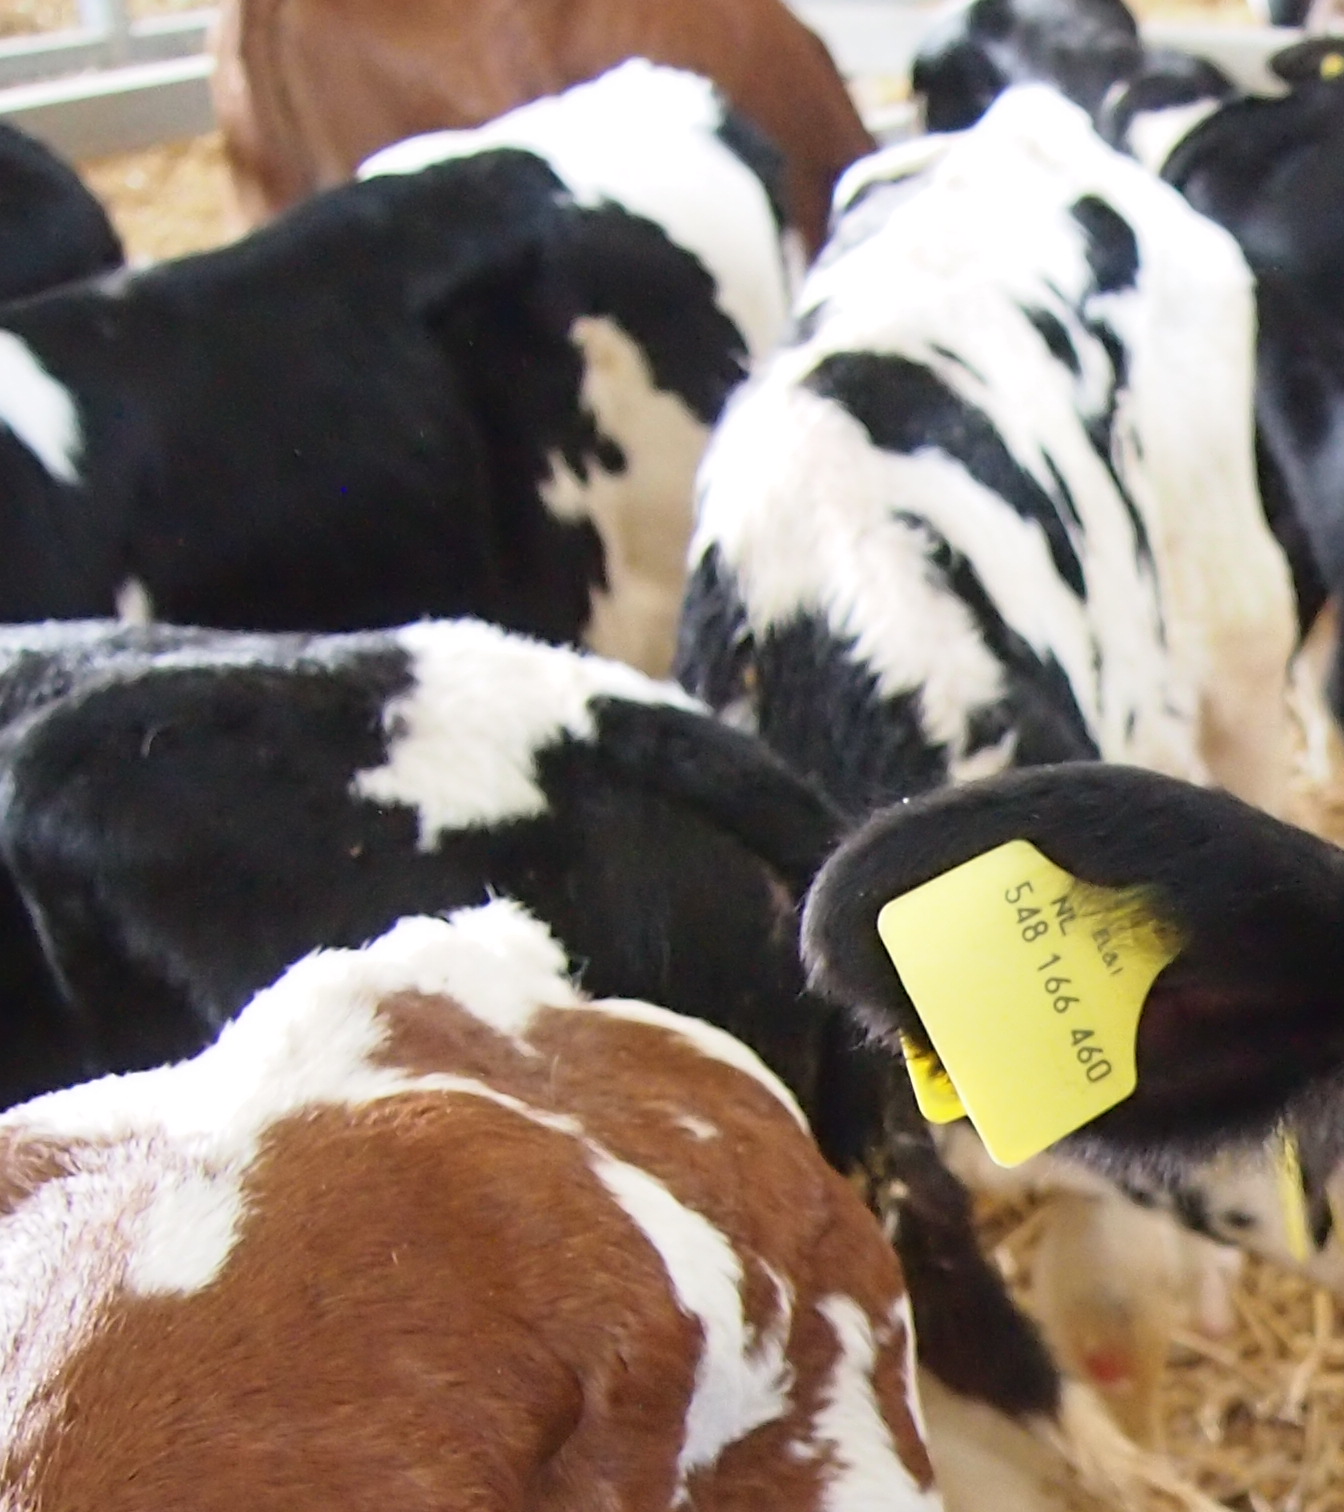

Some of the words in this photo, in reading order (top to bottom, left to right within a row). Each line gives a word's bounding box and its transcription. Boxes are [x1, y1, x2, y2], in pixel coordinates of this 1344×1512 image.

[1051, 894, 1078, 937] NL
[1004, 880, 1049, 943] 548
[1037, 953, 1080, 1015] 166
[1070, 1027, 1113, 1085] 460
